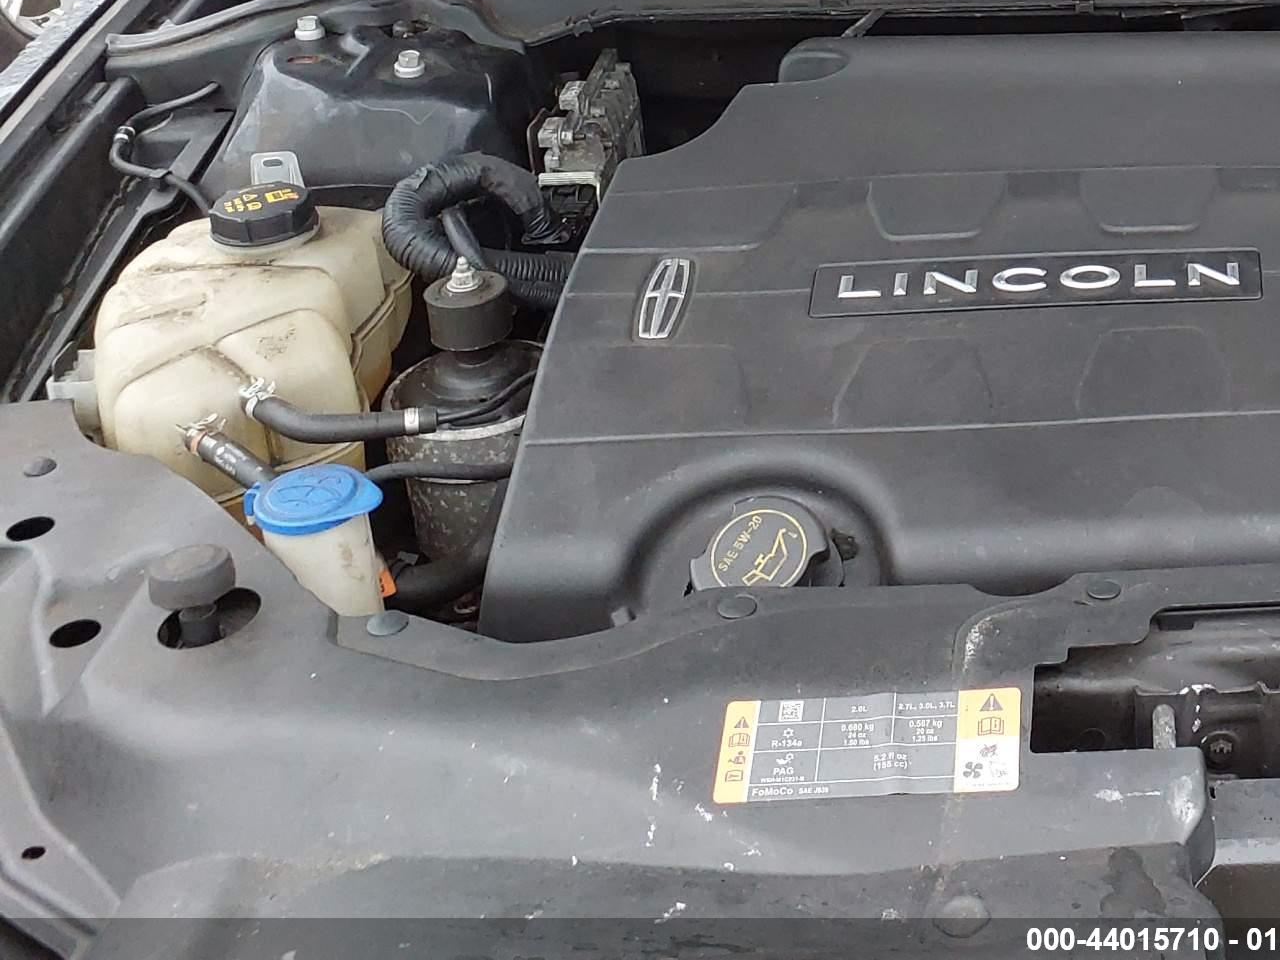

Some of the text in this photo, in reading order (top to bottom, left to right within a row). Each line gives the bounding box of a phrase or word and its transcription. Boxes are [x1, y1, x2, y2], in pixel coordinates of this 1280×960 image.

[837, 261, 1241, 299] LINCOLN
[718, 548, 739, 572] SAE
[864, 723, 875, 732] kg
[932, 720, 943, 729] kg
[771, 739, 803, 749] R-134a
[773, 767, 794, 776] PAG
[751, 787, 794, 797] FoMoCo
